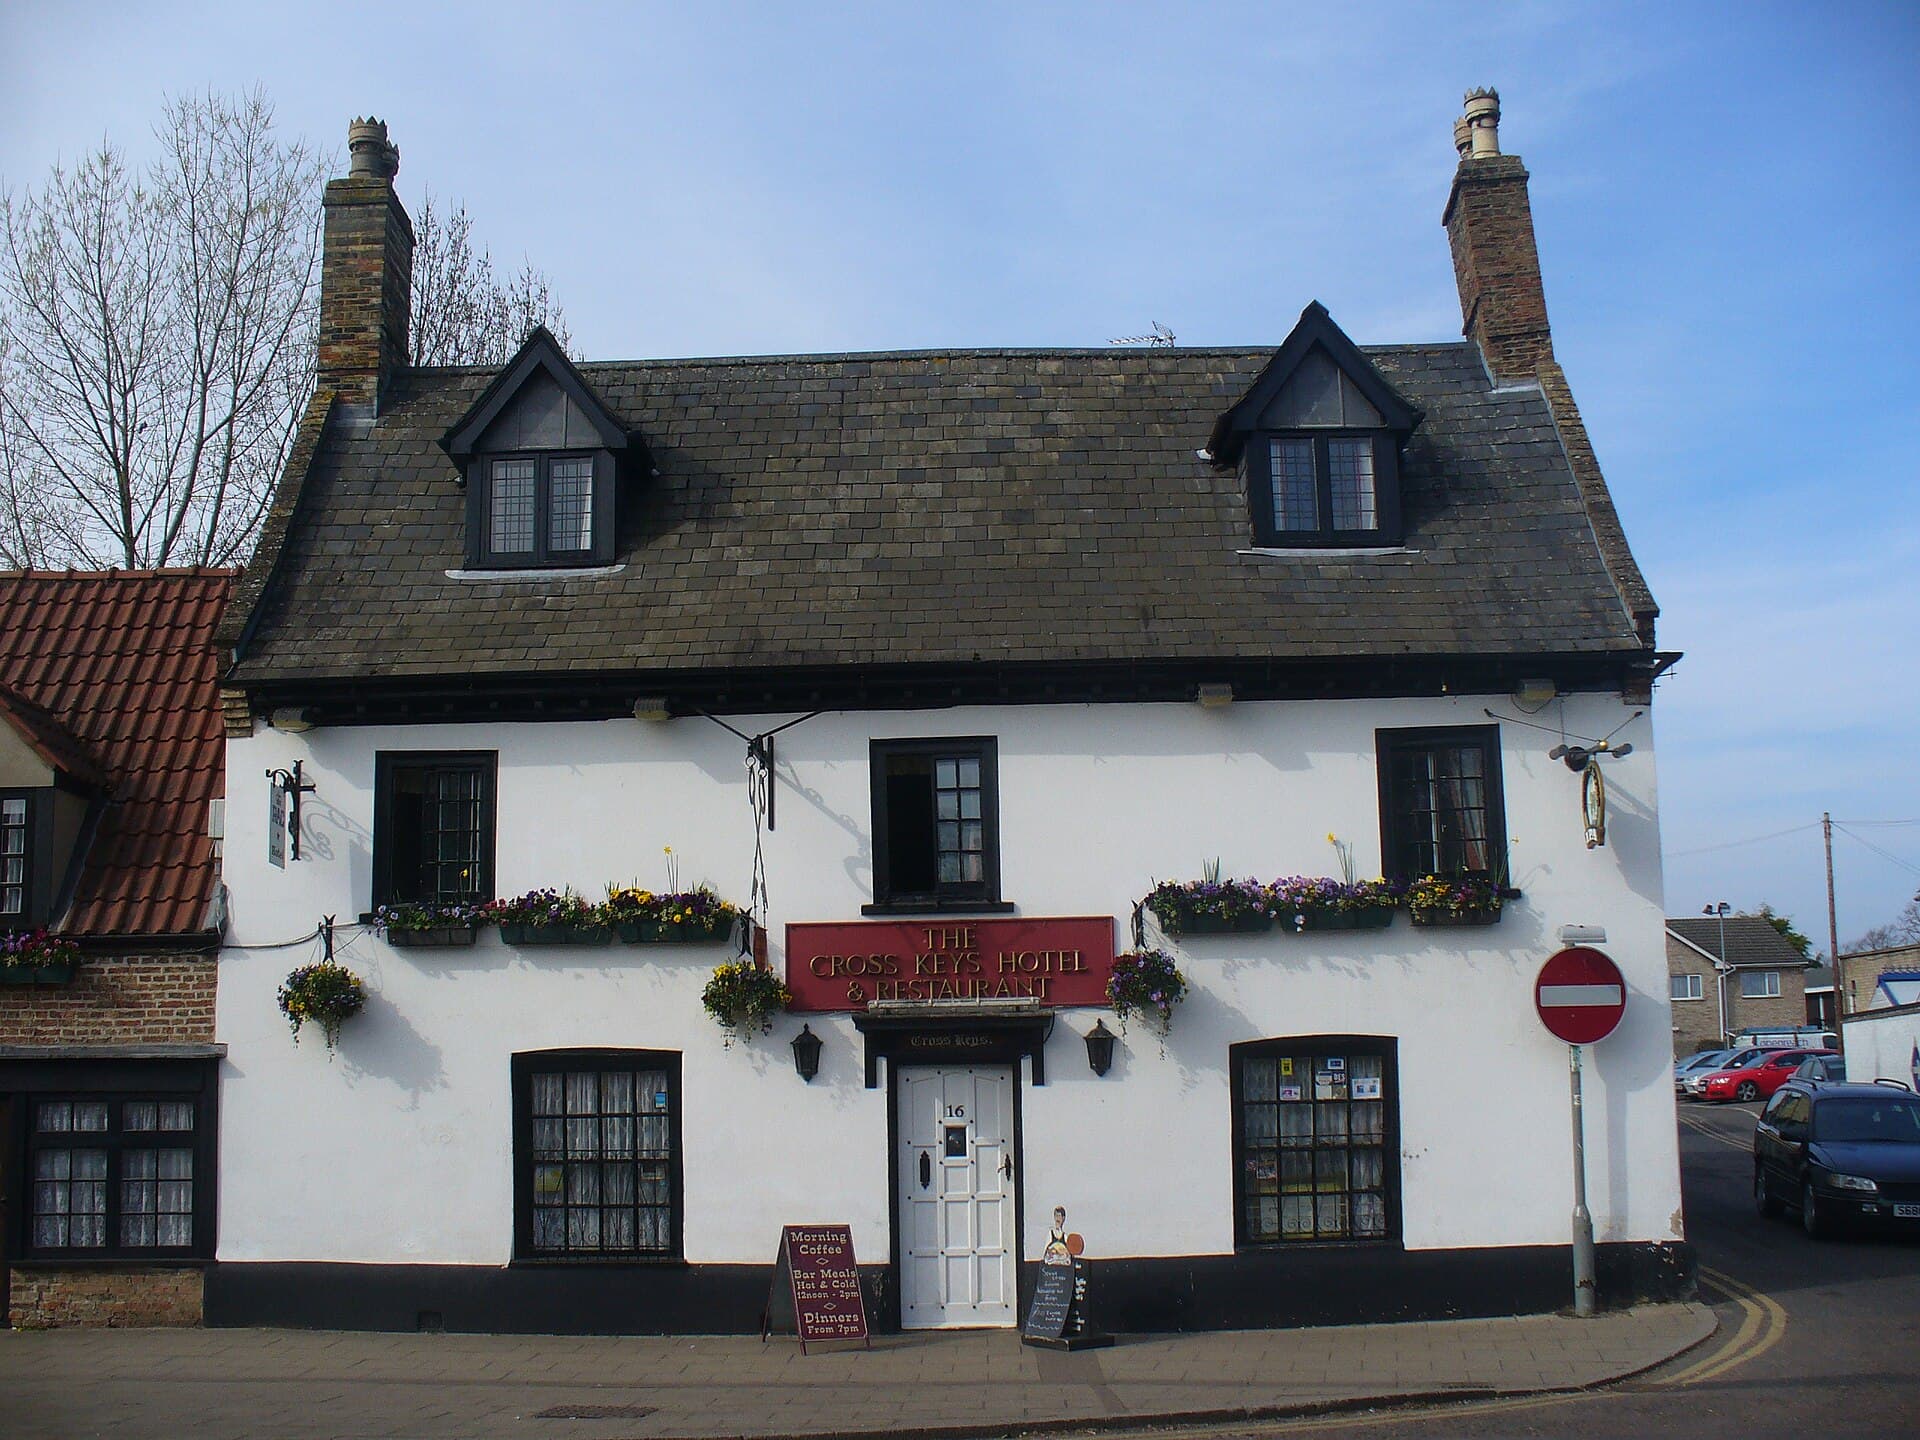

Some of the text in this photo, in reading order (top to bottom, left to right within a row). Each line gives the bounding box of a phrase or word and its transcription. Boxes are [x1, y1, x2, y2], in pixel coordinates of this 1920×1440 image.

[922, 927, 977, 950] THE
[809, 949, 1088, 977] CROSS KEYS HOTEL
[846, 976, 1054, 1002] & RESTAURANT
[910, 1035, 951, 1048] Cross
[946, 1105, 965, 1117] 16
[1897, 1206, 1920, 1216] S68
[790, 1231, 848, 1245] Morning
[799, 1244, 842, 1255] Coffee
[793, 1268, 857, 1279] Bar Meals
[796, 1279, 856, 1290] Hot & Cold
[797, 1291, 829, 1299] 12noon
[839, 1290, 859, 1300] 2pm
[803, 1312, 859, 1324] Dinners
[807, 1324, 859, 1335] From 7pm
